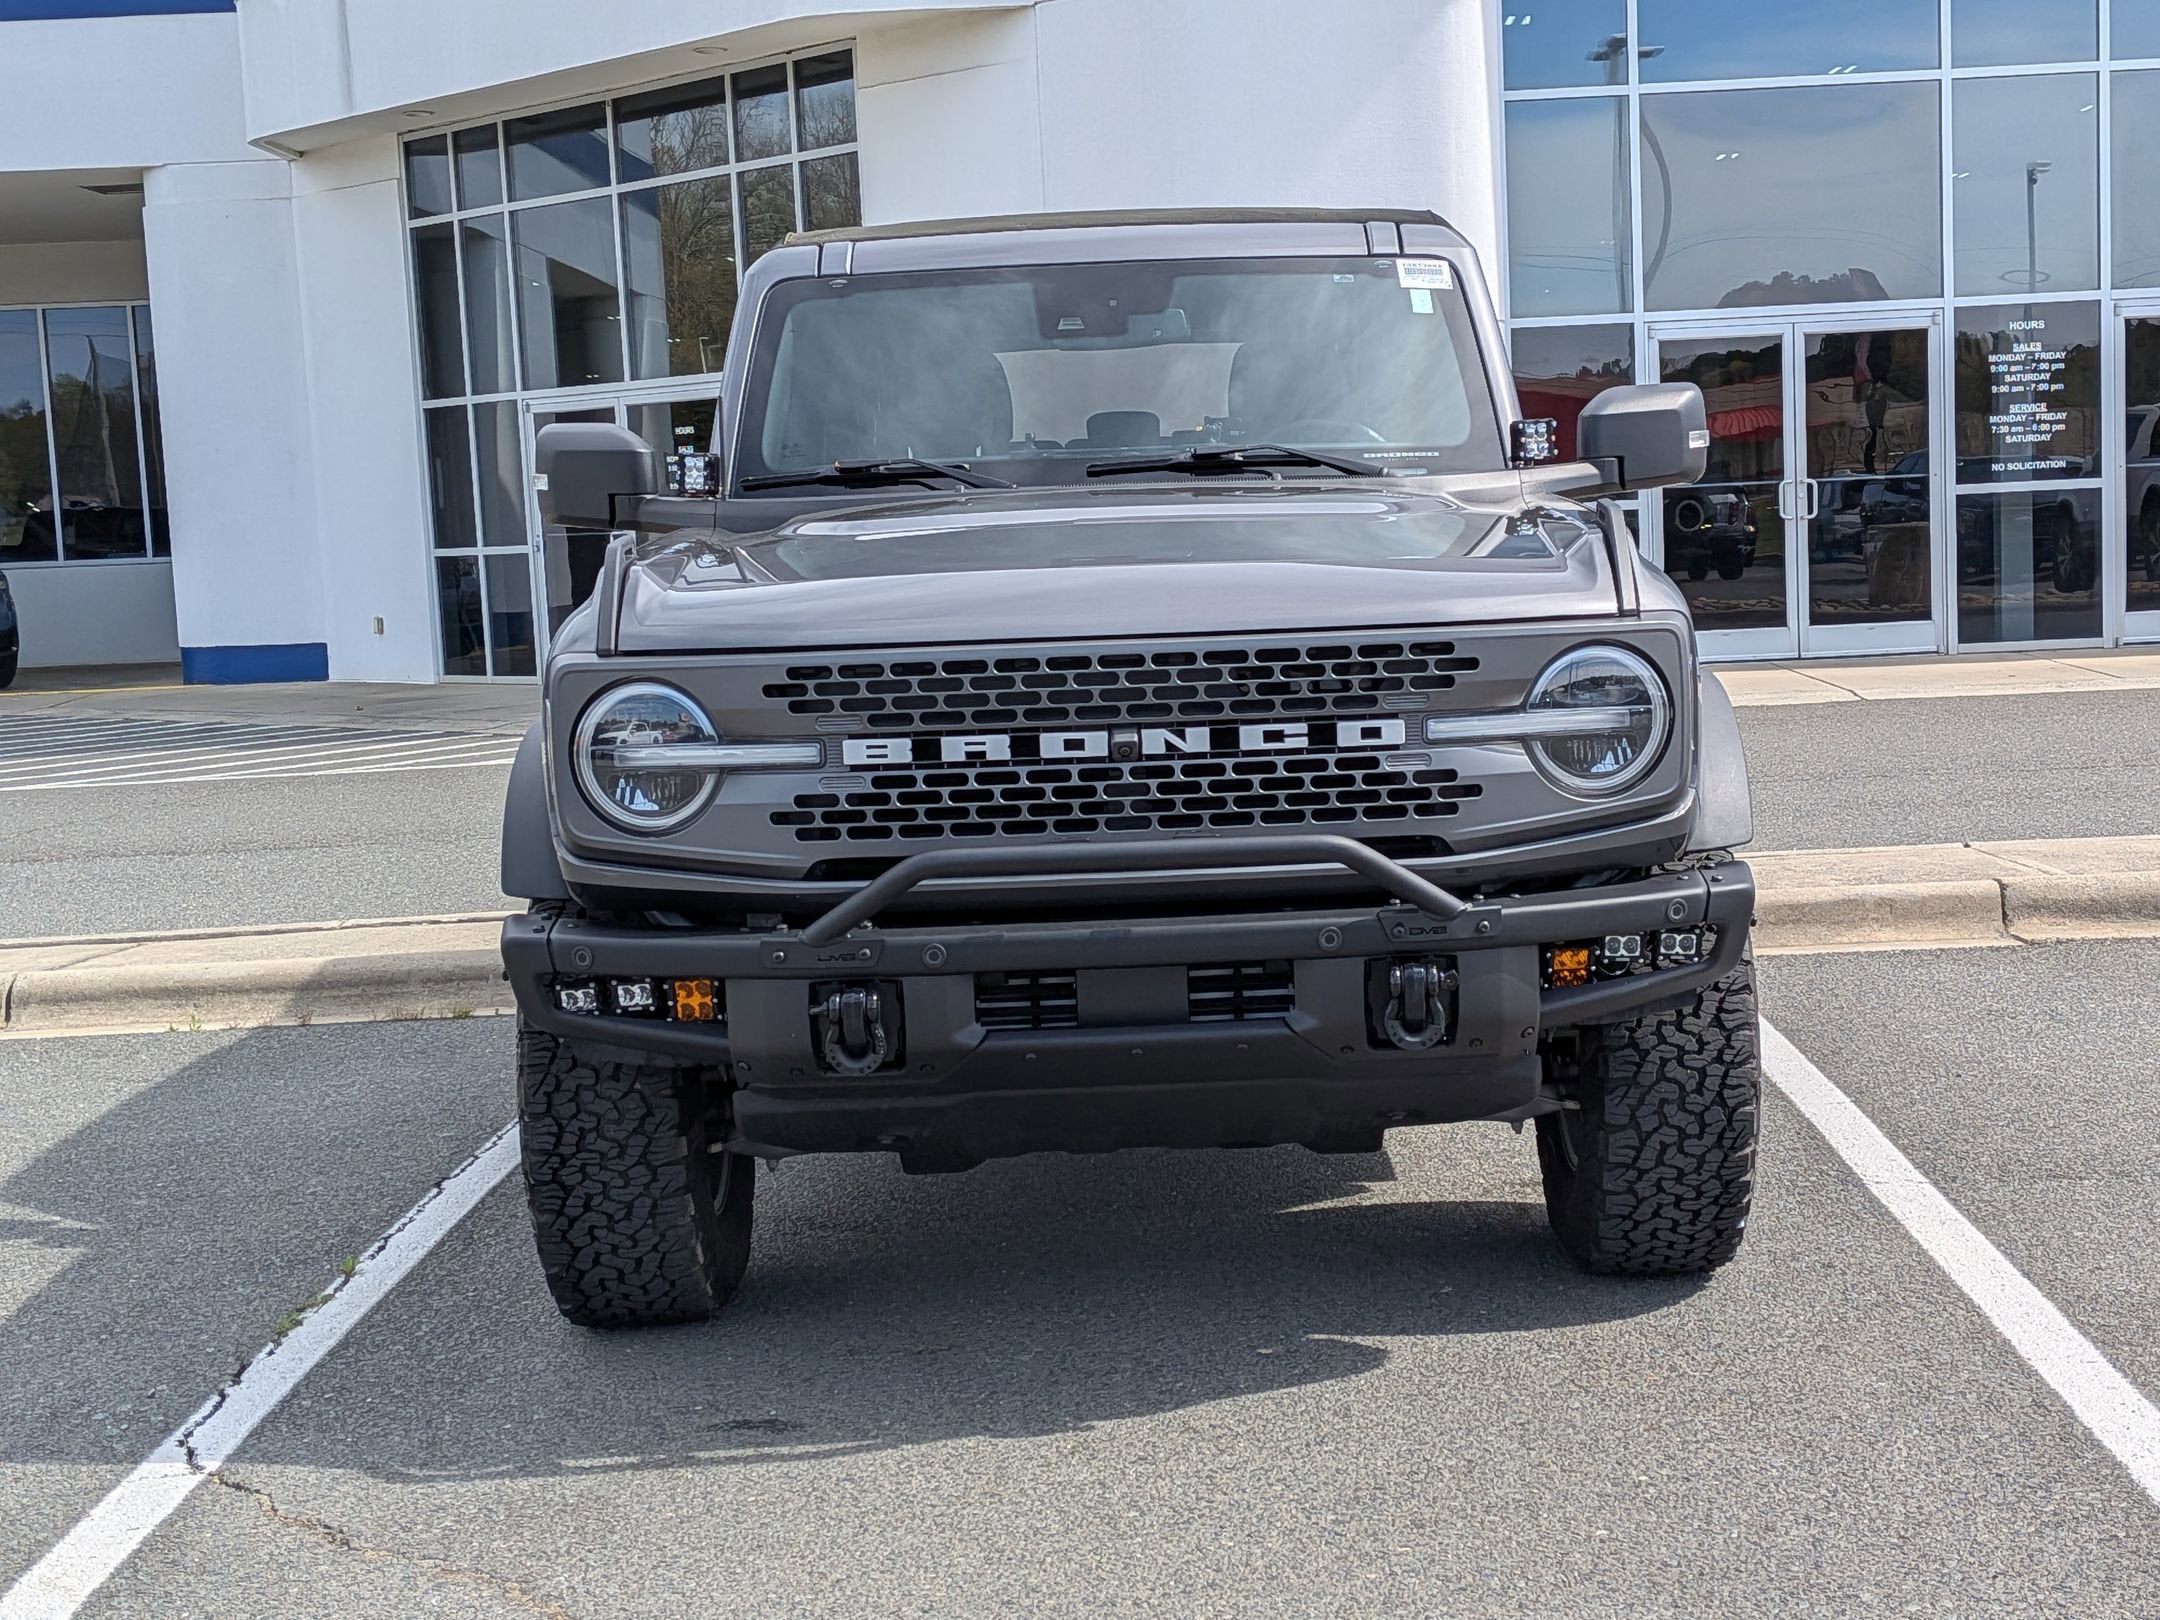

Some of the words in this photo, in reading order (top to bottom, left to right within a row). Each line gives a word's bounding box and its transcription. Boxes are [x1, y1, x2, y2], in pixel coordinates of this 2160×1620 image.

[2009, 320, 2045, 330] HOURS
[2013, 342, 2042, 351] SALES
[1988, 353, 2026, 362] MONDAY
[2034, 351, 2067, 360] FRIDAY
[1990, 364, 2008, 373] 9:00
[2031, 362, 2050, 371] 7:00
[2051, 363, 2065, 371] pm
[2004, 372, 2051, 382] SATURDAY
[1991, 385, 2009, 393] 9:00
[2031, 383, 2049, 391] 7:00
[2050, 384, 2065, 392] pm
[2009, 402, 2048, 413] SERVICE
[1989, 414, 2027, 423] MONDAY
[2035, 412, 2068, 421] FRIDAY
[1991, 425, 2009, 433] 7:30
[2052, 424, 2066, 432] pm
[2005, 433, 2052, 443] SATURDAY
[1991, 463, 2005, 471] NO
[2007, 460, 2067, 471] SOLICITATION
[842, 719, 1405, 765] BRONCO
